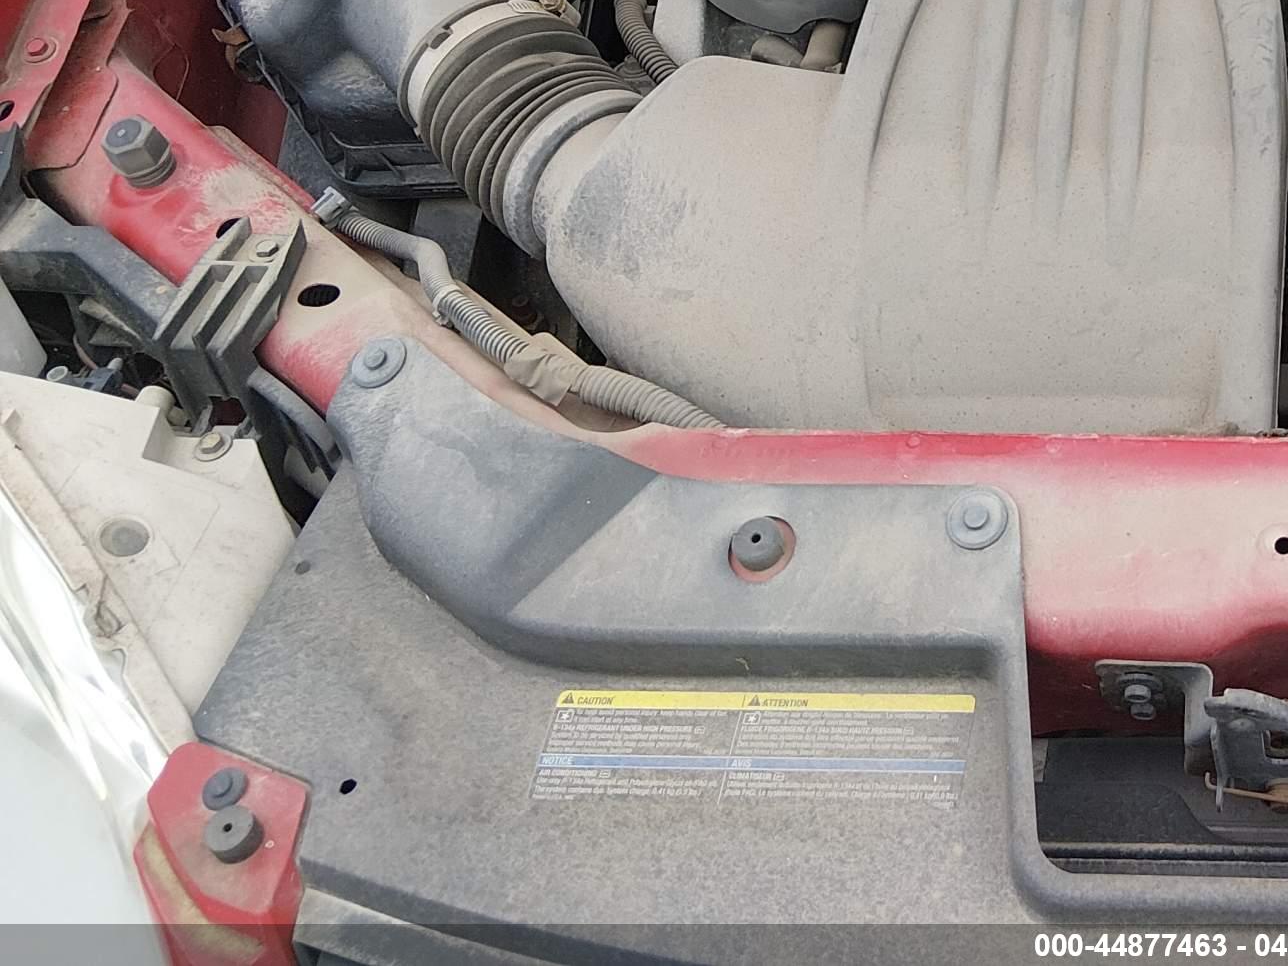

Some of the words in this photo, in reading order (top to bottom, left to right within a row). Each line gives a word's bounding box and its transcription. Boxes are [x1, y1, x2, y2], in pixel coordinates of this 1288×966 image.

[577, 696, 615, 705] CAUTION
[762, 698, 809, 707] ATTENTION
[542, 755, 574, 765] NOTICE
[730, 758, 752, 768] AVIS
